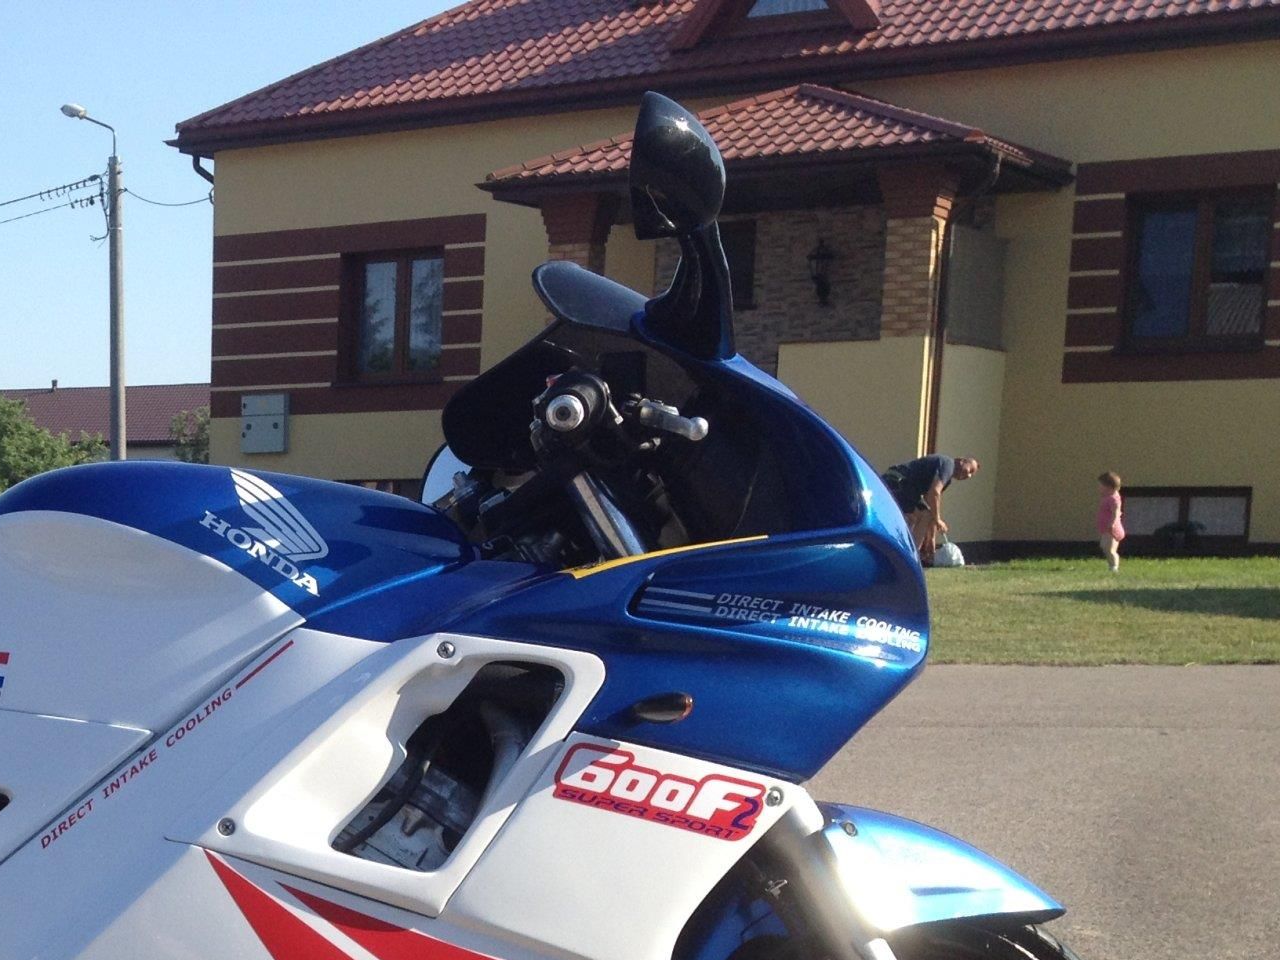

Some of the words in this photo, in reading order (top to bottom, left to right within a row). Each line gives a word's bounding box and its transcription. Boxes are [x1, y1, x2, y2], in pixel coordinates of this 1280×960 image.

[199, 510, 320, 597] HONDA
[714, 606, 781, 624] DIRECT
[787, 616, 850, 635] INTAKE
[716, 592, 783, 611] DIRECT
[789, 603, 851, 623] INTAKE
[856, 616, 920, 641] COOLING
[40, 798, 94, 849] DIRECT
[101, 748, 158, 799] INTAKE
[165, 688, 232, 748] COOLING
[560, 789, 648, 816] SUPER
[653, 812, 739, 840] SPORT
